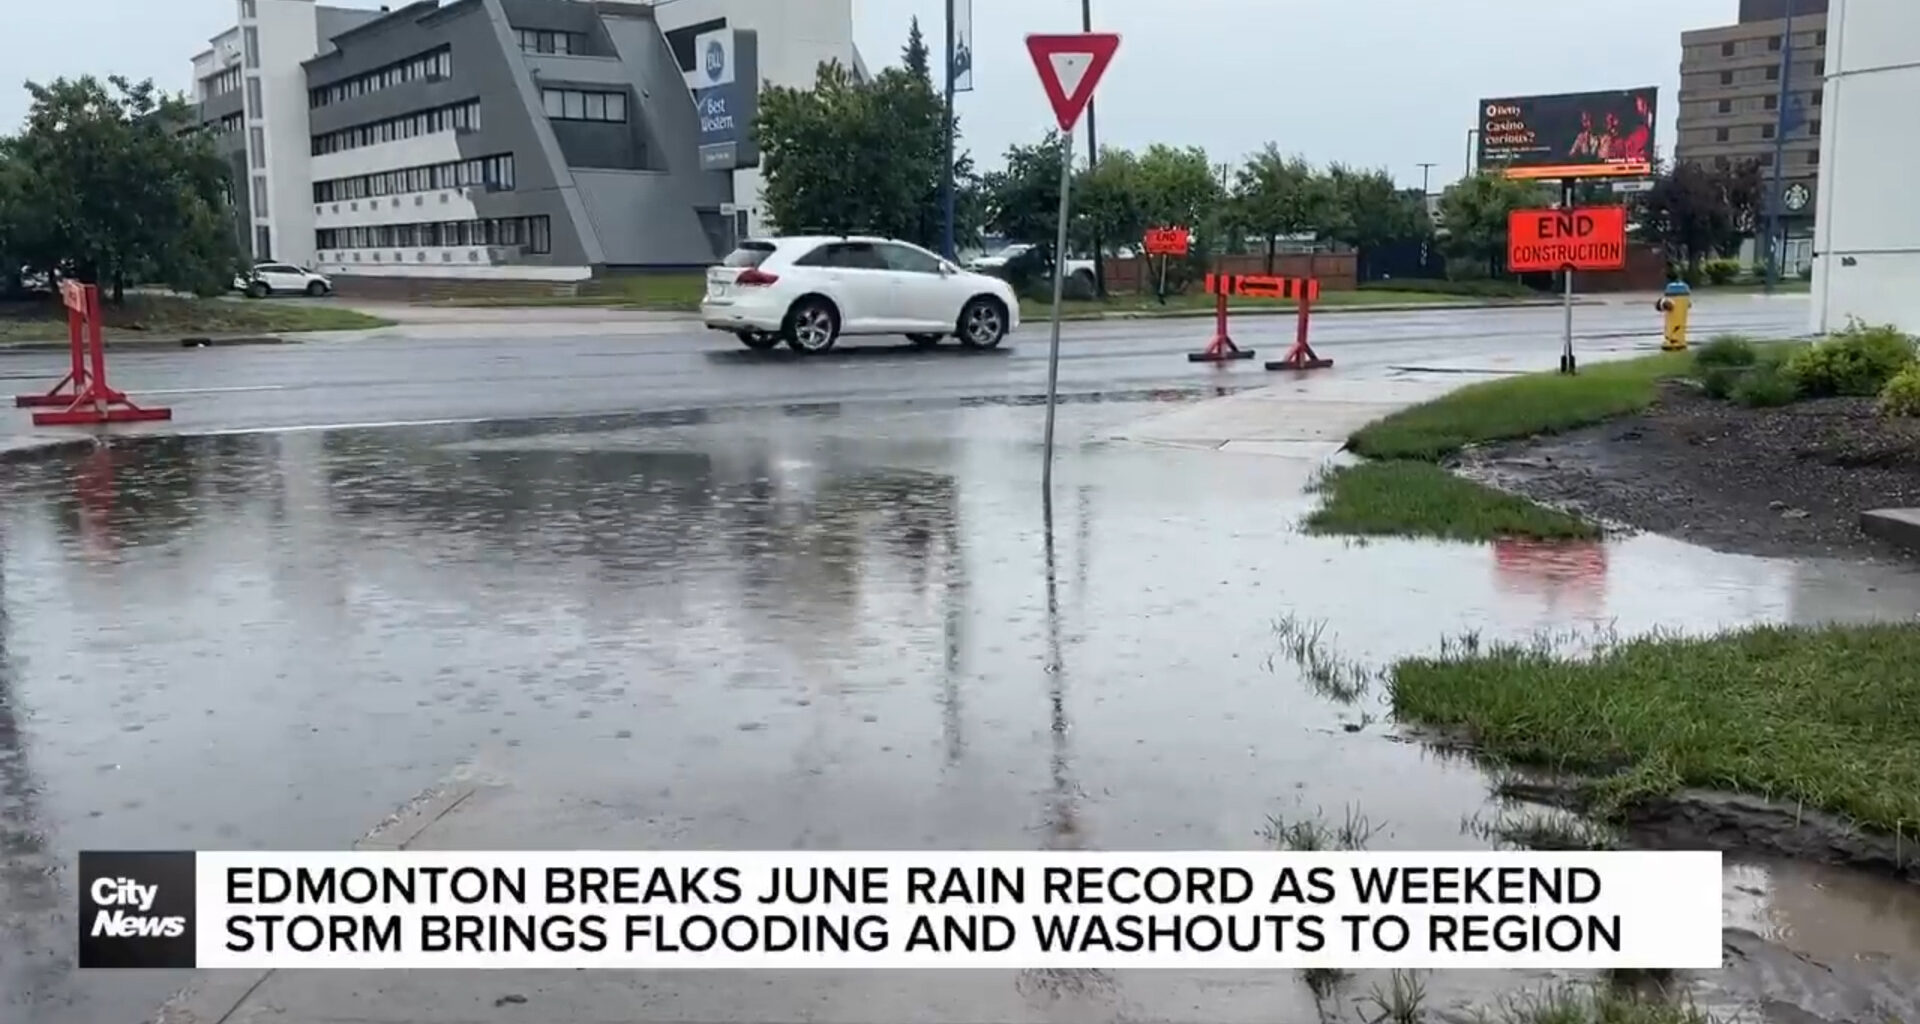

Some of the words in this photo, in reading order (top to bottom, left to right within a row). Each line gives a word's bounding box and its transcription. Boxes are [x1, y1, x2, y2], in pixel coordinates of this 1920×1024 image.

[707, 98, 726, 115] Best
[701, 115, 734, 132] Western
[1485, 120, 1524, 132] Casino
[1485, 131, 1535, 145] curious?
[1538, 215, 1594, 239] END
[1513, 242, 1620, 263] CONSTRUCTION
